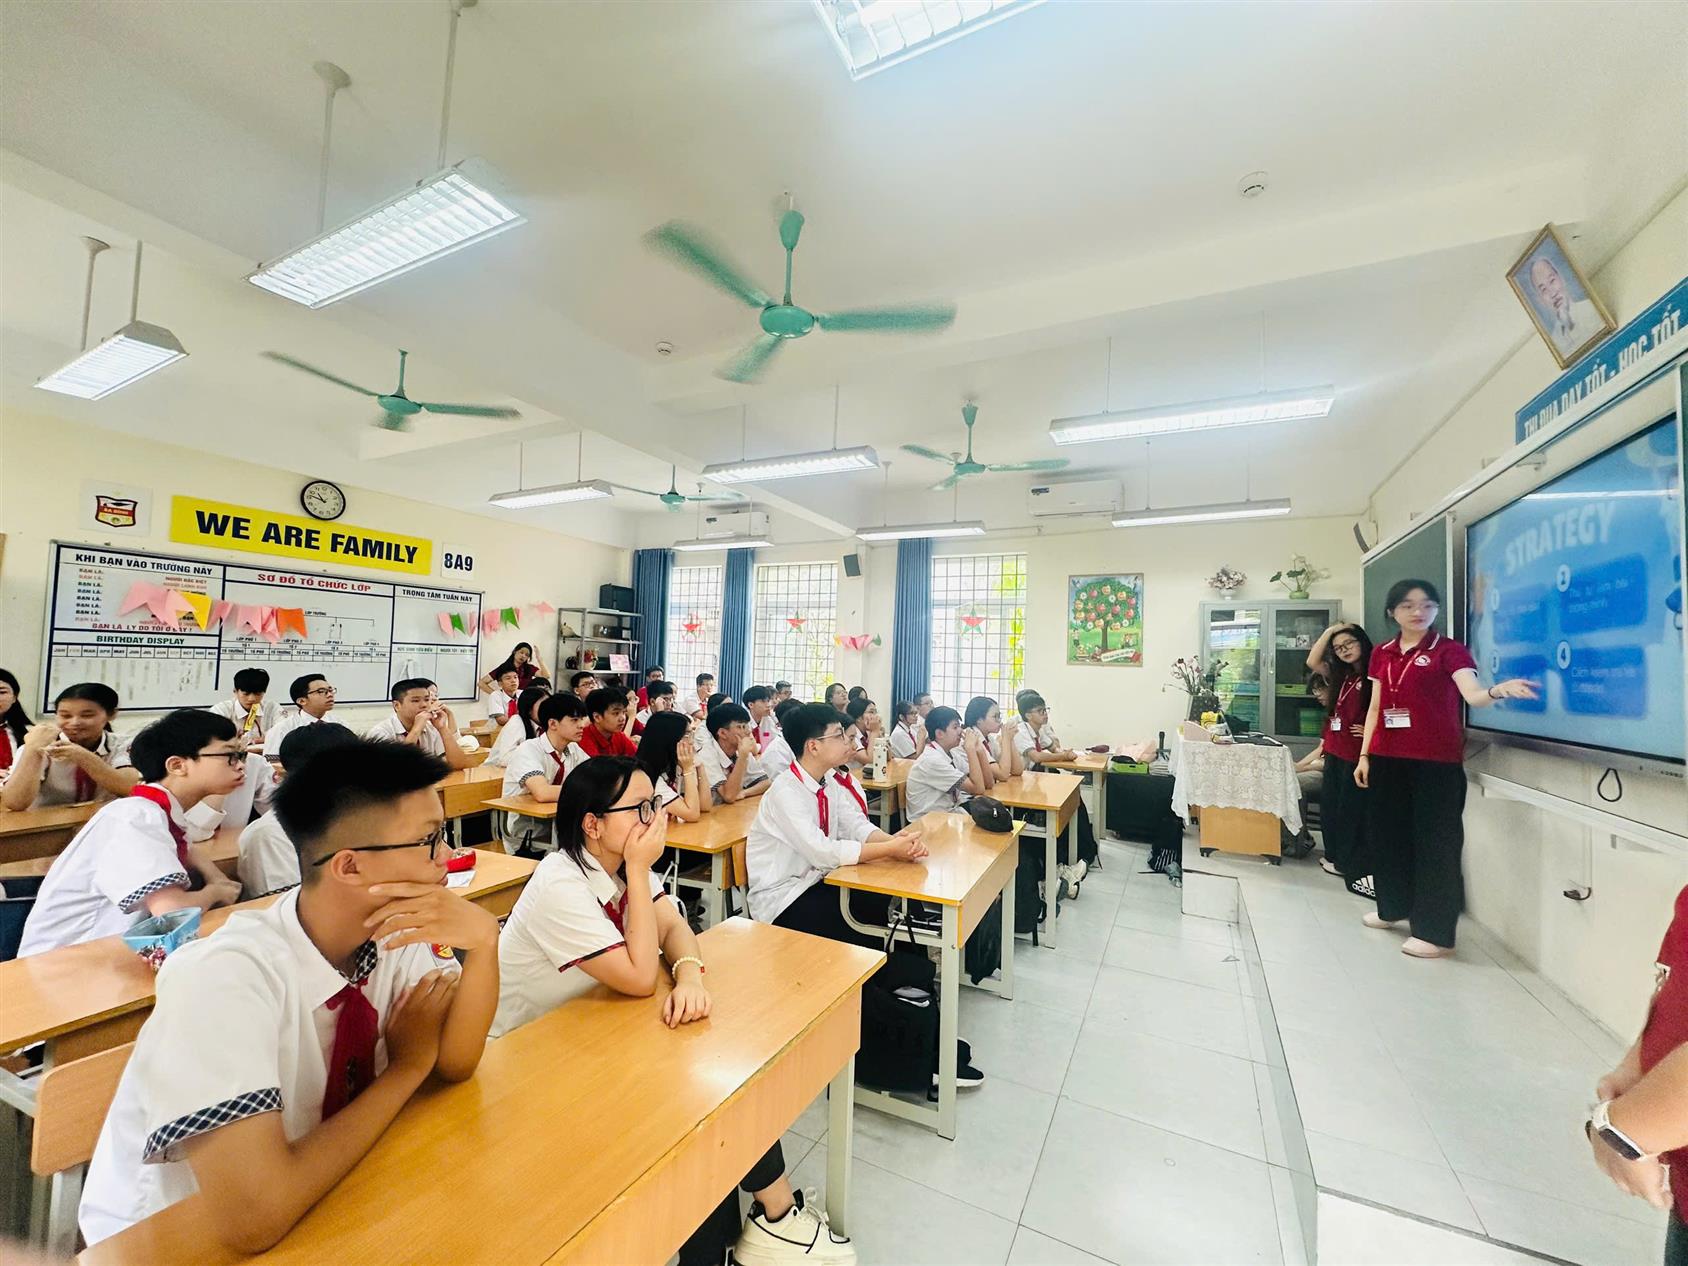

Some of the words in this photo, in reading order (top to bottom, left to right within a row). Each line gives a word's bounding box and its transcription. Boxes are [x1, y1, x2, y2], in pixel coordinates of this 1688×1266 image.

[196, 510, 250, 540] WE
[261, 522, 320, 550] ARE
[330, 533, 418, 564] FAMILY
[1504, 500, 1616, 575] STRATEGY
[76, 554, 95, 563] KHI
[444, 553, 472, 571] 8A9
[96, 636, 144, 644] BIRTHDAY
[1352, 883, 1376, 896] adida
